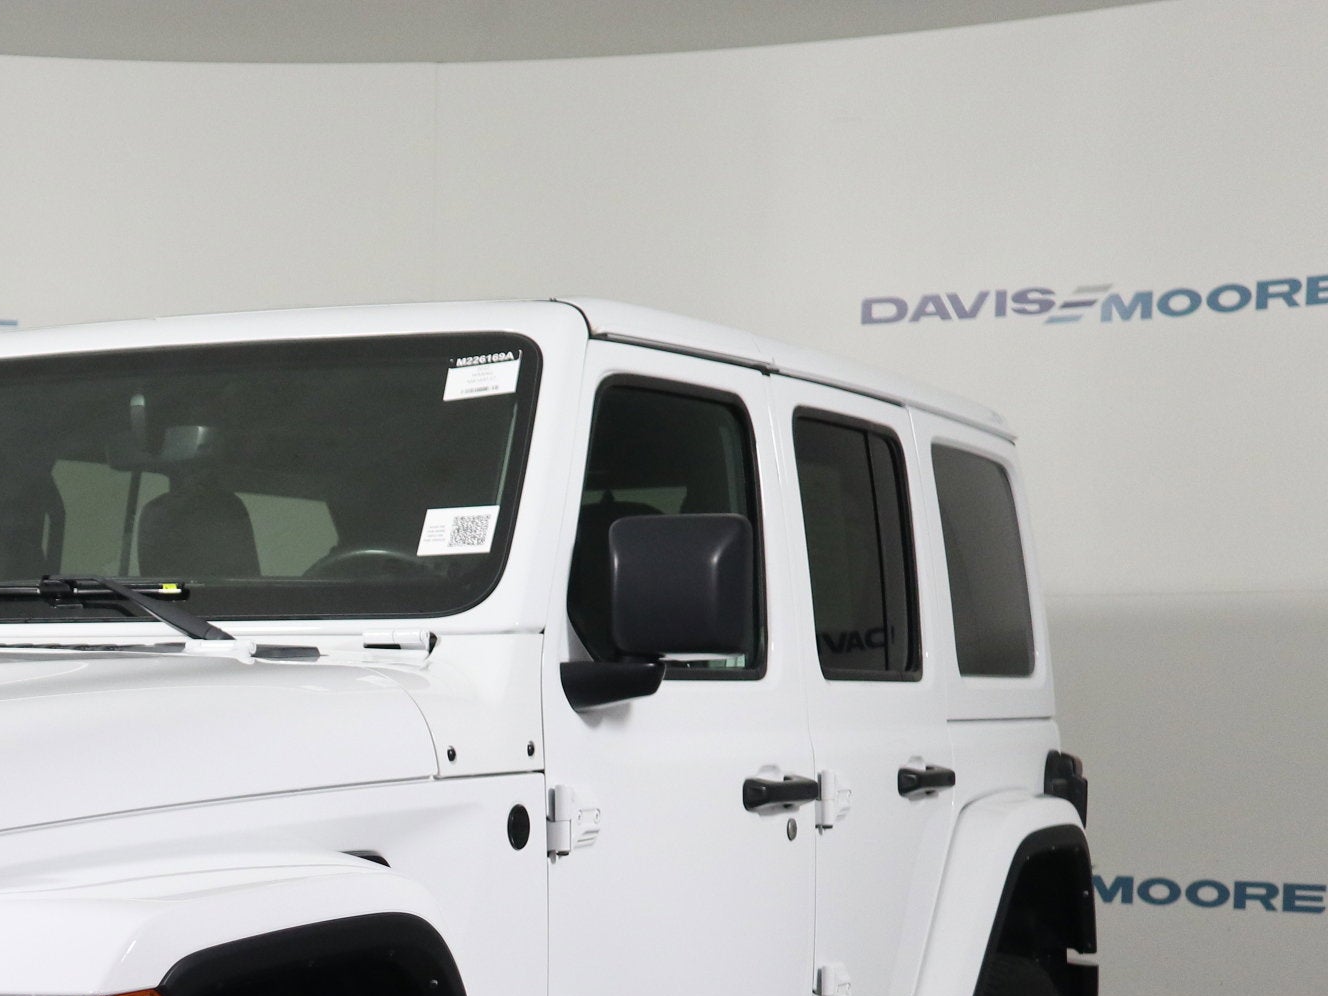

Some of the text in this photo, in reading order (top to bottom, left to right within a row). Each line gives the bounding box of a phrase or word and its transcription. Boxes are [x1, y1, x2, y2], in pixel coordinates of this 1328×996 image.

[861, 286, 1056, 325] DAVIS
[456, 351, 515, 367] M226169A
[1092, 874, 1328, 914] MOORE
